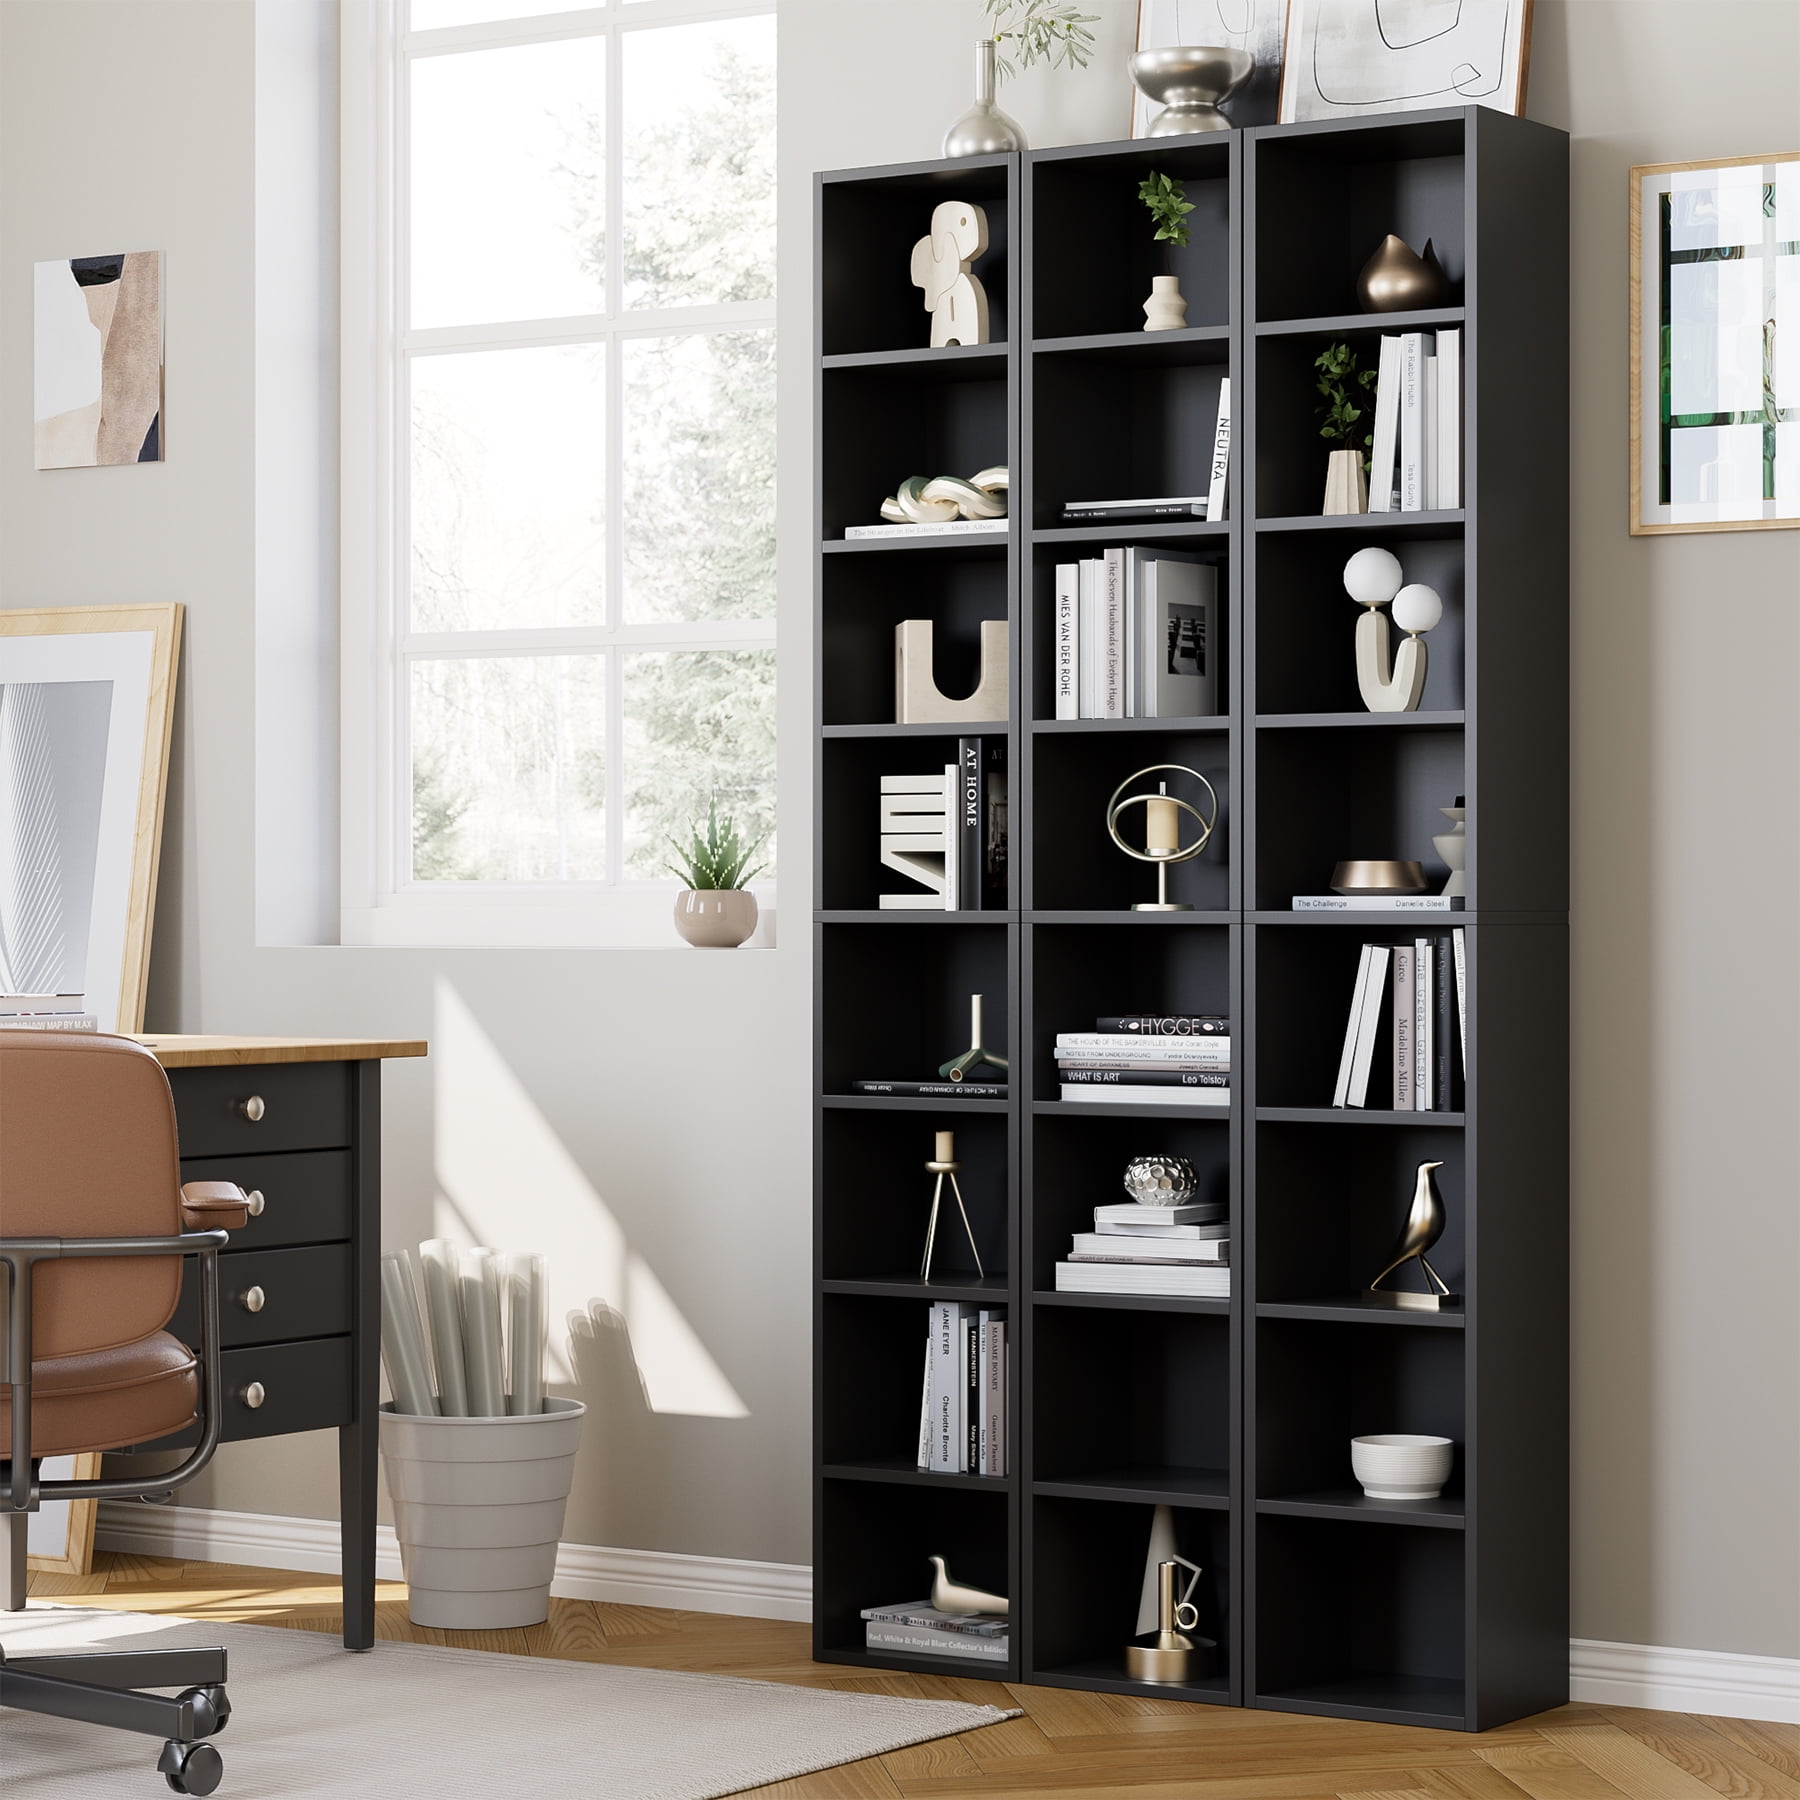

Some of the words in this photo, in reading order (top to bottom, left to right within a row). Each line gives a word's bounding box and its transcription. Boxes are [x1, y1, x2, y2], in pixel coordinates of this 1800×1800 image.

[1408, 338, 1416, 354] The
[1408, 356, 1416, 382] Rabbit
[1408, 384, 1416, 408] Hutch
[1213, 418, 1230, 480] NEUTRA
[1407, 464, 1416, 481] Tess
[867, 528, 895, 537] Stranger
[905, 527, 916, 535] the
[1109, 560, 1119, 576] The
[1109, 577, 1118, 602] Seven
[1060, 595, 1070, 618] MIES
[1060, 622, 1070, 642] VAN
[1109, 604, 1119, 646] Husbands
[1060, 645, 1070, 666] DER
[1106, 648, 1120, 658] of
[1060, 670, 1070, 697] ROHE
[1106, 660, 1119, 685] Evelyn
[1106, 687, 1118, 711] Hugo
[966, 748, 977, 770] AT
[966, 776, 977, 827] HOME
[1312, 899, 1347, 909] Challenge
[1395, 899, 1424, 907] Danielle
[1426, 899, 1445, 907] Steel
[1399, 955, 1408, 983] Circe
[1417, 957, 1425, 980] The
[1417, 989, 1425, 1030] Great
[47, 1020, 63, 1030] MAP
[63, 1020, 74, 1029] BY
[1141, 1018, 1200, 1035] HYGGE
[1068, 1038, 1079, 1046] THE
[1080, 1038, 1100, 1046] HOUND
[1101, 1038, 1111, 1046] OF
[1124, 1039, 1167, 1047] BASKERVILLES
[1203, 1040, 1219, 1049] Doyle
[1399, 1018, 1408, 1067] Madeline
[1104, 1051, 1151, 1059] UNDERGROUND
[1416, 1039, 1425, 1089] Gatsby
[1067, 1072, 1091, 1081] WHAT
[1093, 1073, 1101, 1082] IS
[1102, 1073, 1120, 1082] ART
[1182, 1074, 1198, 1084] Leo
[1199, 1074, 1227, 1086] Tolstoy
[1399, 1070, 1408, 1103] Miller
[942, 1307, 950, 1331] JANE
[942, 1332, 950, 1356] EYER
[991, 1326, 999, 1361] MADAME
[991, 1362, 999, 1391] BOVARY
[942, 1395, 950, 1433] Charlotte
[942, 1435, 950, 1462] Bronte
[892, 1614, 903, 1622] The
[904, 1616, 927, 1626] Danish
[929, 1620, 939, 1629] Art
[939, 1621, 947, 1629] of
[948, 1622, 981, 1634] Happiness
[868, 1633, 883, 1642] Red,
[884, 1634, 904, 1643] White
[912, 1637, 930, 1648] Royal
[948, 1641, 983, 1653] Collector's
[984, 1645, 1007, 1655] Edition
